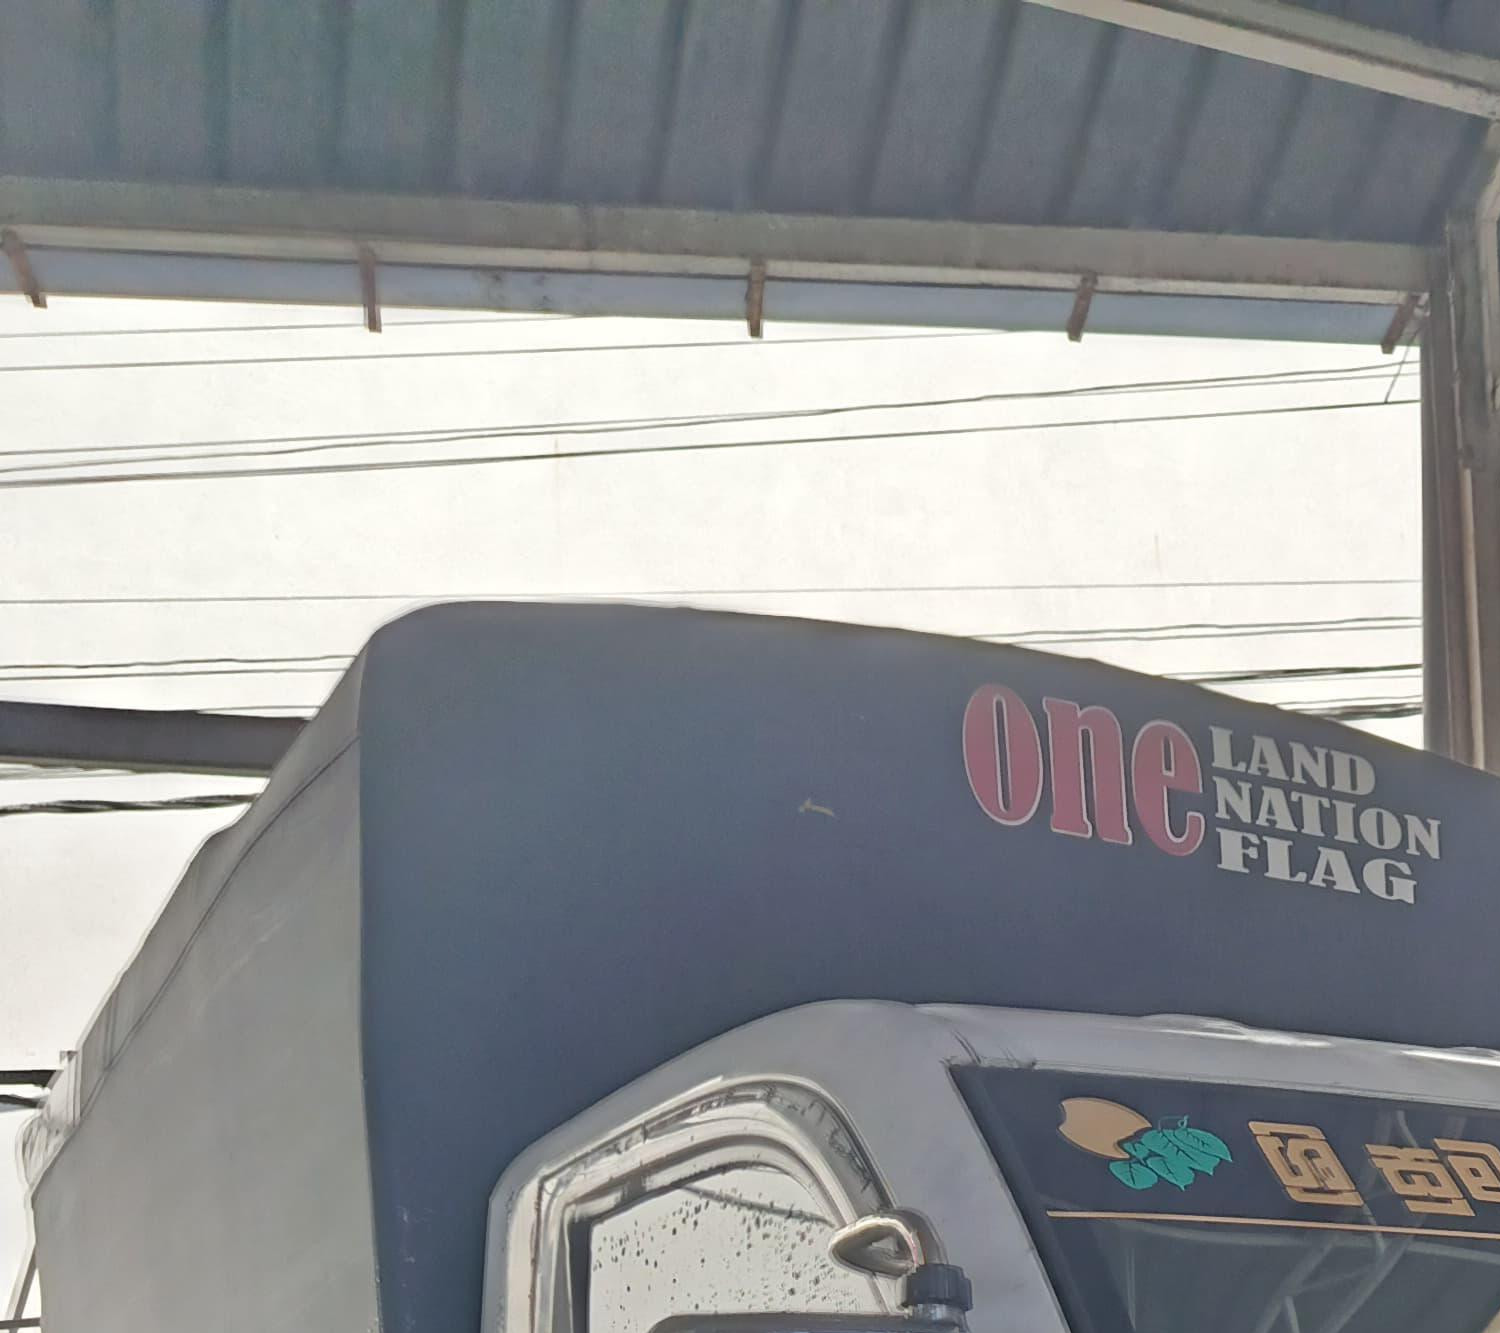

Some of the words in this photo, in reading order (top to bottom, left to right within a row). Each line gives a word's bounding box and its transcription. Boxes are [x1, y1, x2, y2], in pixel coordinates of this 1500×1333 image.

[962, 683, 1205, 856] one
[1208, 726, 1376, 796] LAND
[1212, 776, 1441, 860] NATION
[1215, 827, 1417, 904] FLAG
